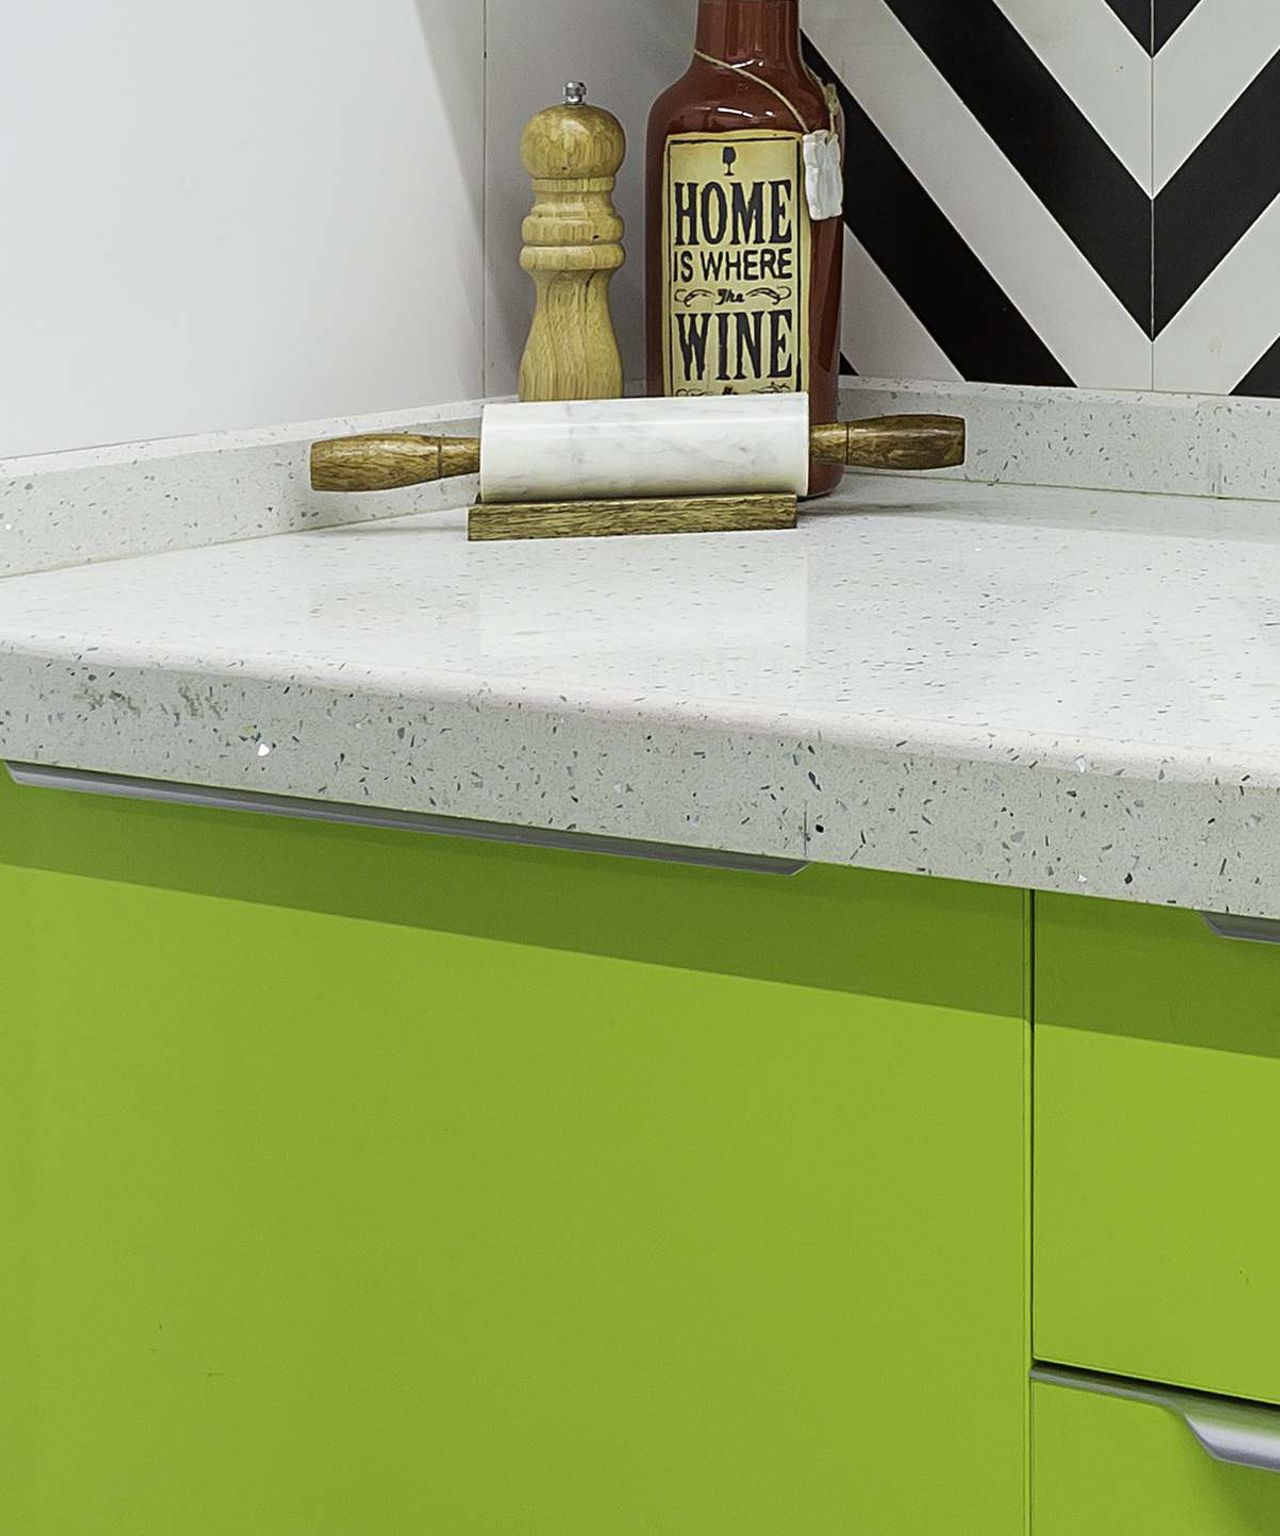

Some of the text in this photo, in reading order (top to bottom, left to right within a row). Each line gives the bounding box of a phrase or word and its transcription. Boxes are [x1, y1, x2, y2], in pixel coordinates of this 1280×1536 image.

[674, 179, 792, 246] HOME
[674, 248, 793, 283] IS WHERE
[714, 287, 746, 306] The
[674, 309, 793, 381] WINE
